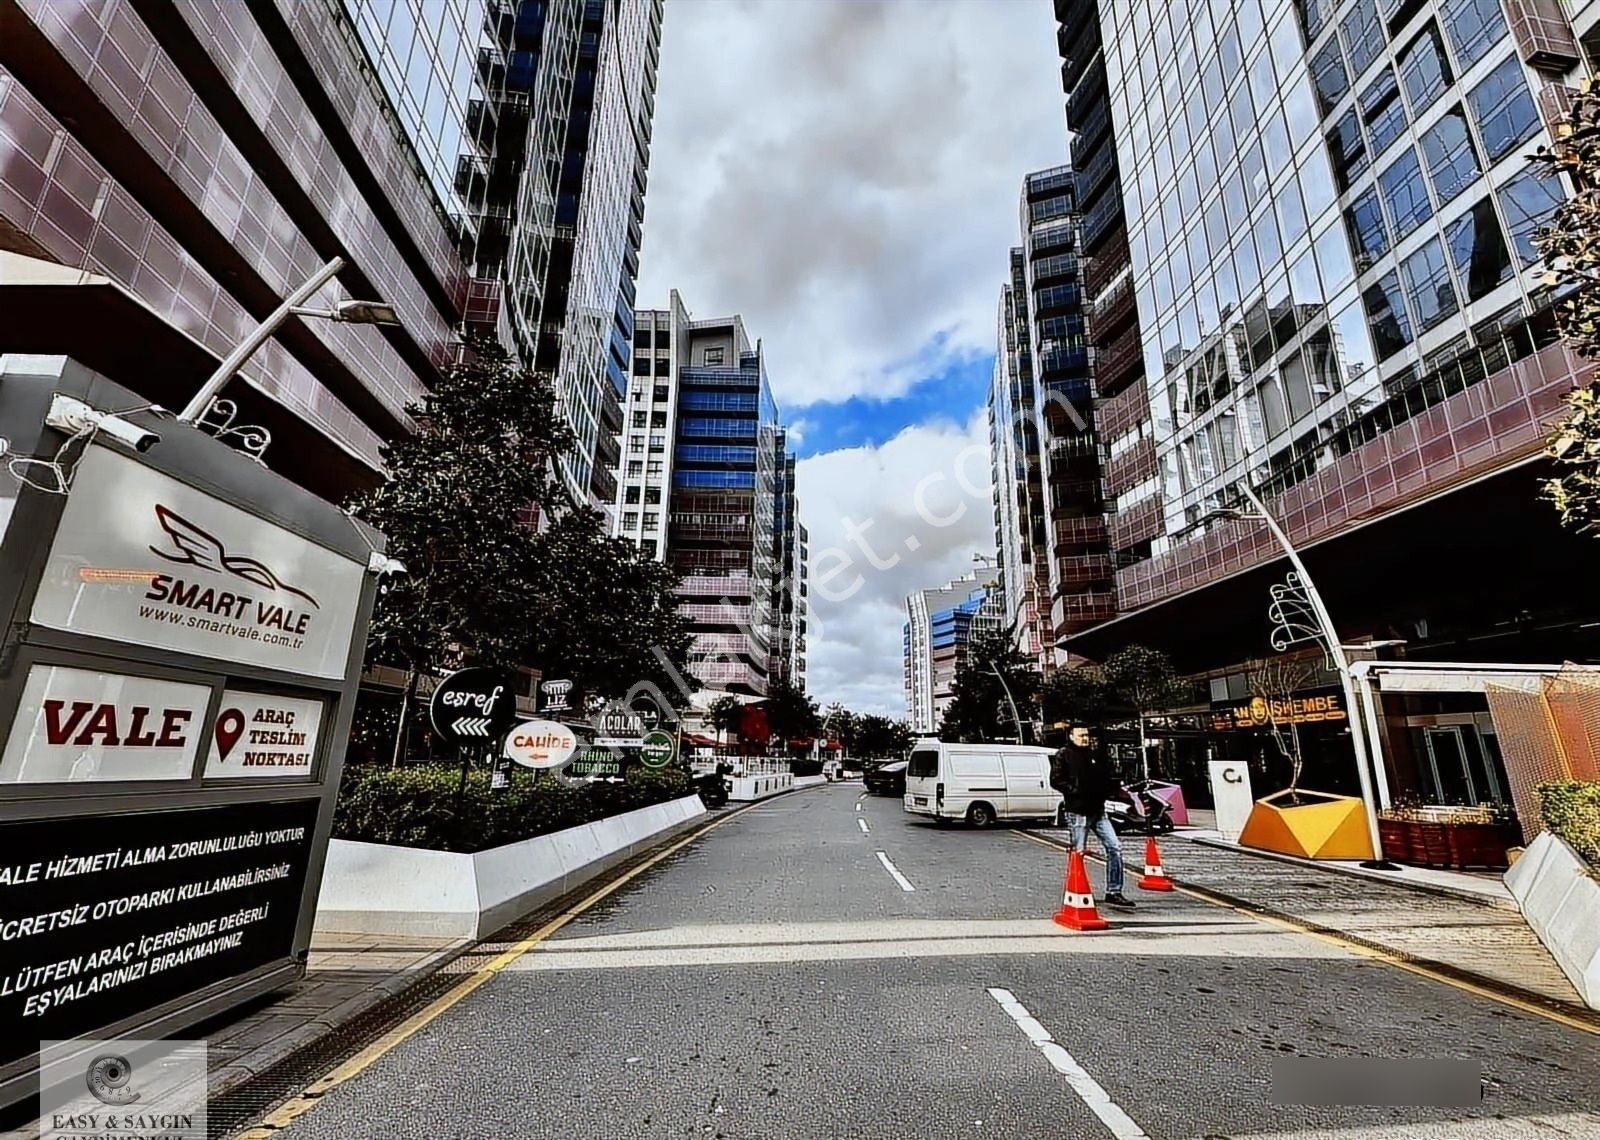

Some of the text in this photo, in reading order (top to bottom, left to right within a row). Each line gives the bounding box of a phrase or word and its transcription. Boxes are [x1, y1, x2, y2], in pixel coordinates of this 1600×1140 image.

[139, 604, 304, 650] www.smartvale.com.tr
[145, 575, 310, 635] SMART VALE
[43, 699, 192, 748] VALE
[252, 708, 295, 729] ARAÇ
[442, 686, 504, 716] eşref
[243, 751, 310, 767] NOKTASI
[249, 727, 307, 746] TESLİM
[513, 733, 571, 749] CAHİDE
[572, 762, 620, 774] TOBACCO
[0, 827, 305, 886] ALE HİZMETİ ALMA ZORUNLULUĞU YOKTUR
[93, 886, 175, 920] OTOPARKI
[177, 863, 291, 901] KULLANABİLİRSİNİZ
[0, 901, 269, 997] LÜTFEN ARAÇ İÇERİSİNDE DEĞERLİ
[23, 931, 244, 1017] EŞYALARINIZI BIRAKMAYINIZ
